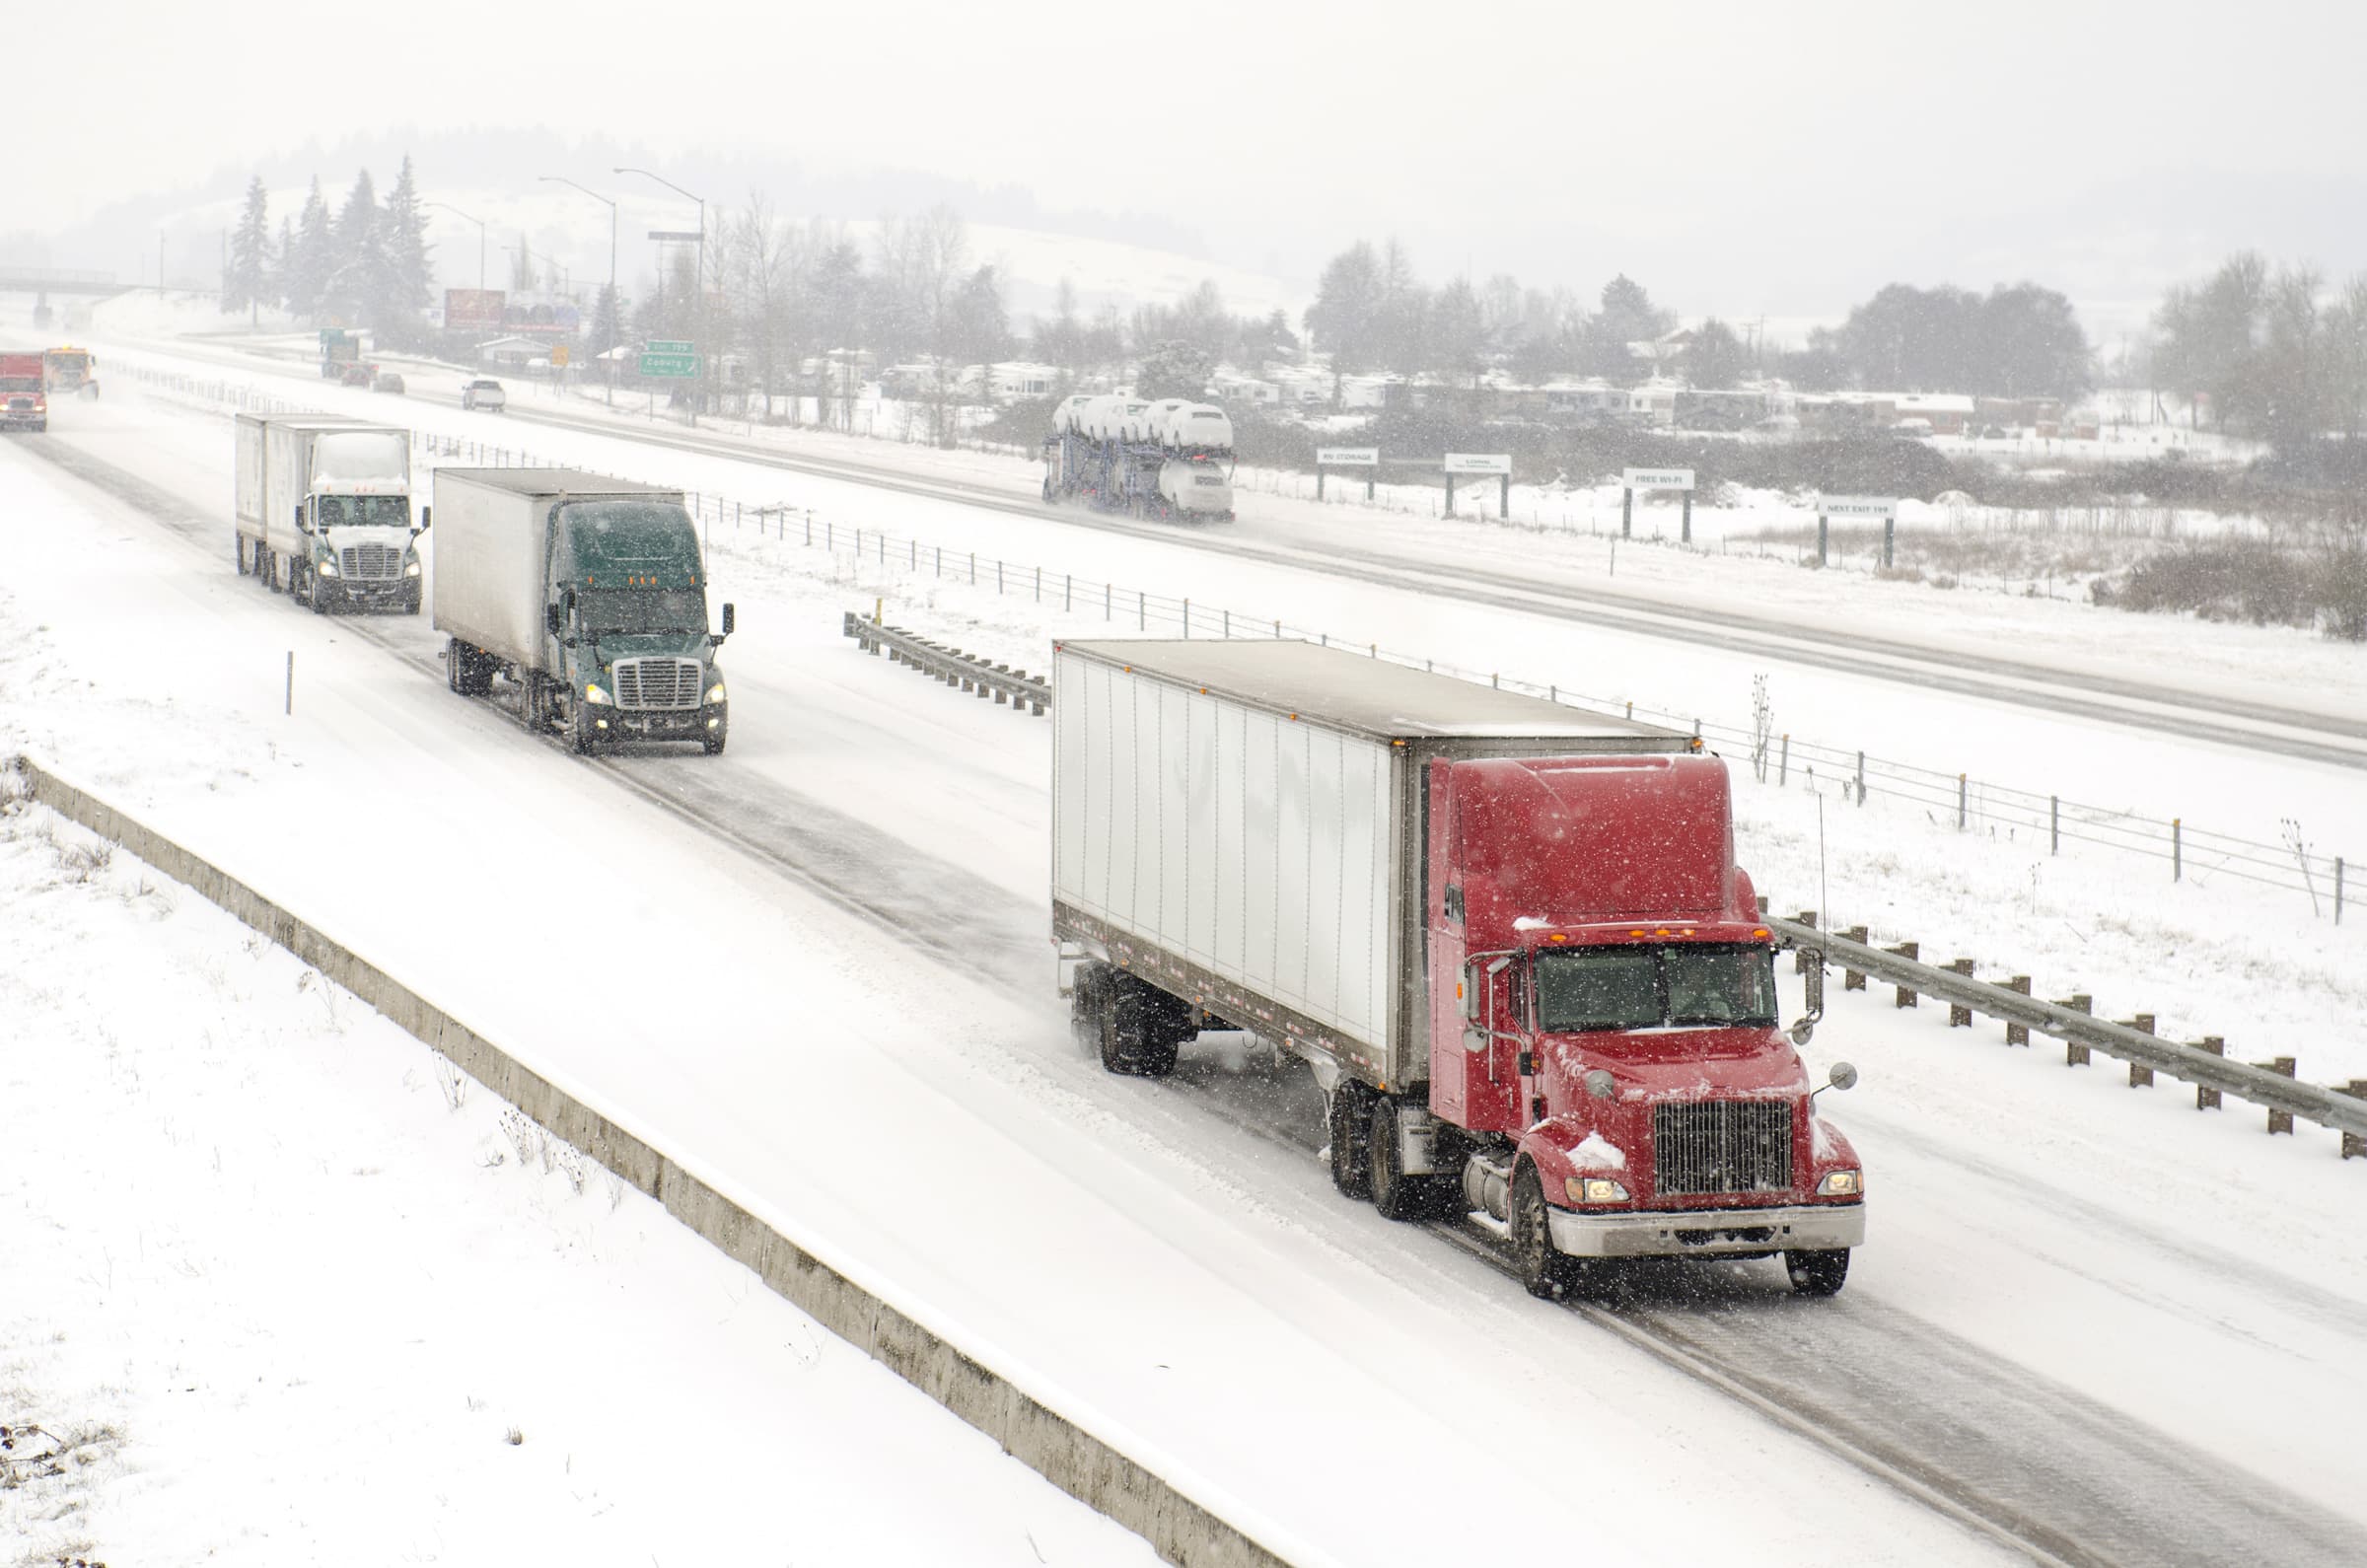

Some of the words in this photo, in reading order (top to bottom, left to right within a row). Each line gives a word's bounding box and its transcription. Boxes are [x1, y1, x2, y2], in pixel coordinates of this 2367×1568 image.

[1335, 453, 1372, 462] STORAGE
[1635, 474, 1658, 483] FREE
[1851, 505, 1871, 514] EXIT
